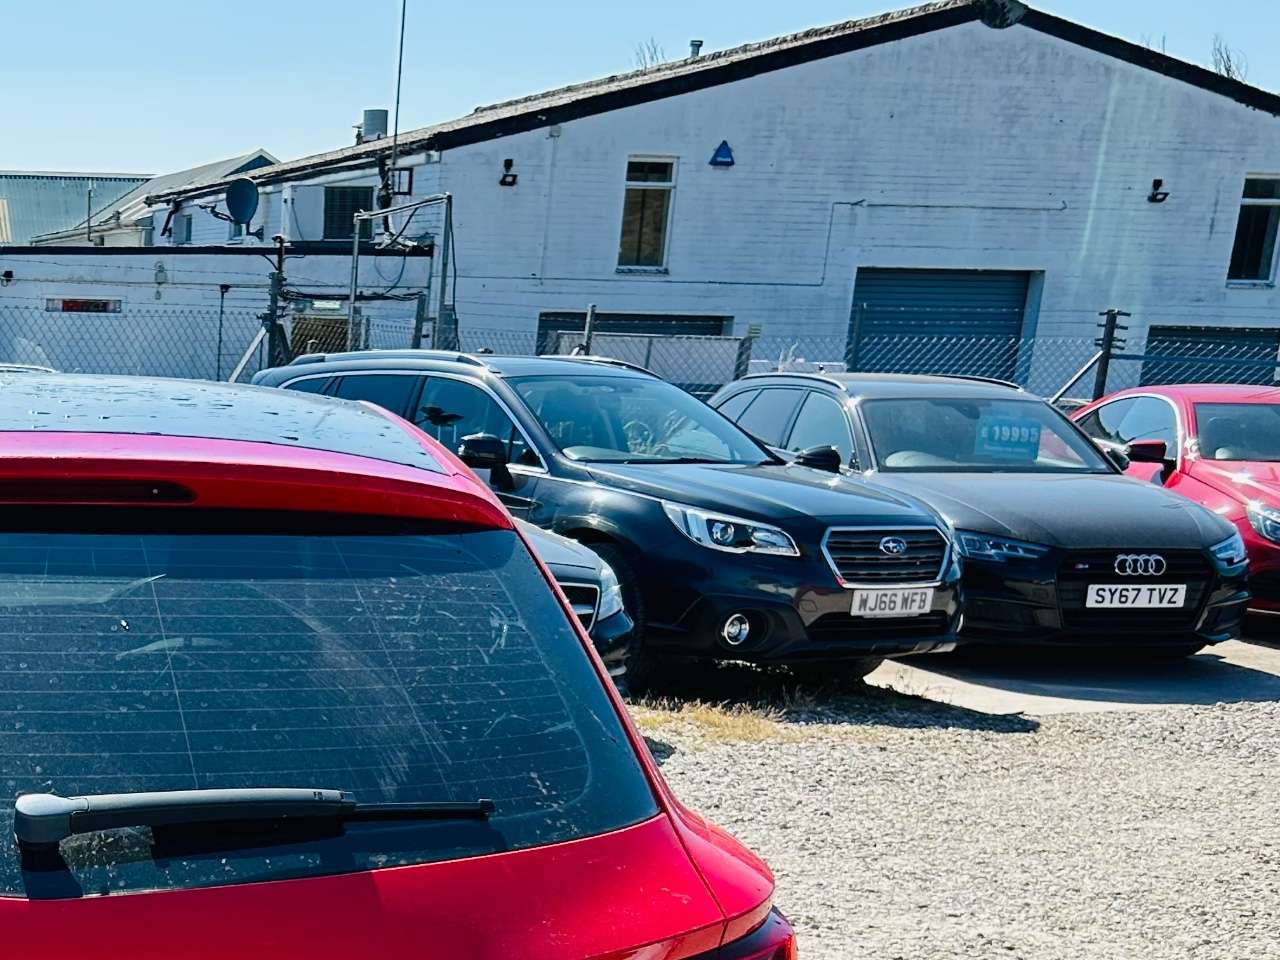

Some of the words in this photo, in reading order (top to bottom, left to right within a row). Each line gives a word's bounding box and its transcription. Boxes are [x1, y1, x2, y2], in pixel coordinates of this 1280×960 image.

[858, 592, 898, 612] WJ66
[900, 591, 928, 611] WFB
[1095, 588, 1141, 604] SY67
[1147, 588, 1179, 604] TVZ
